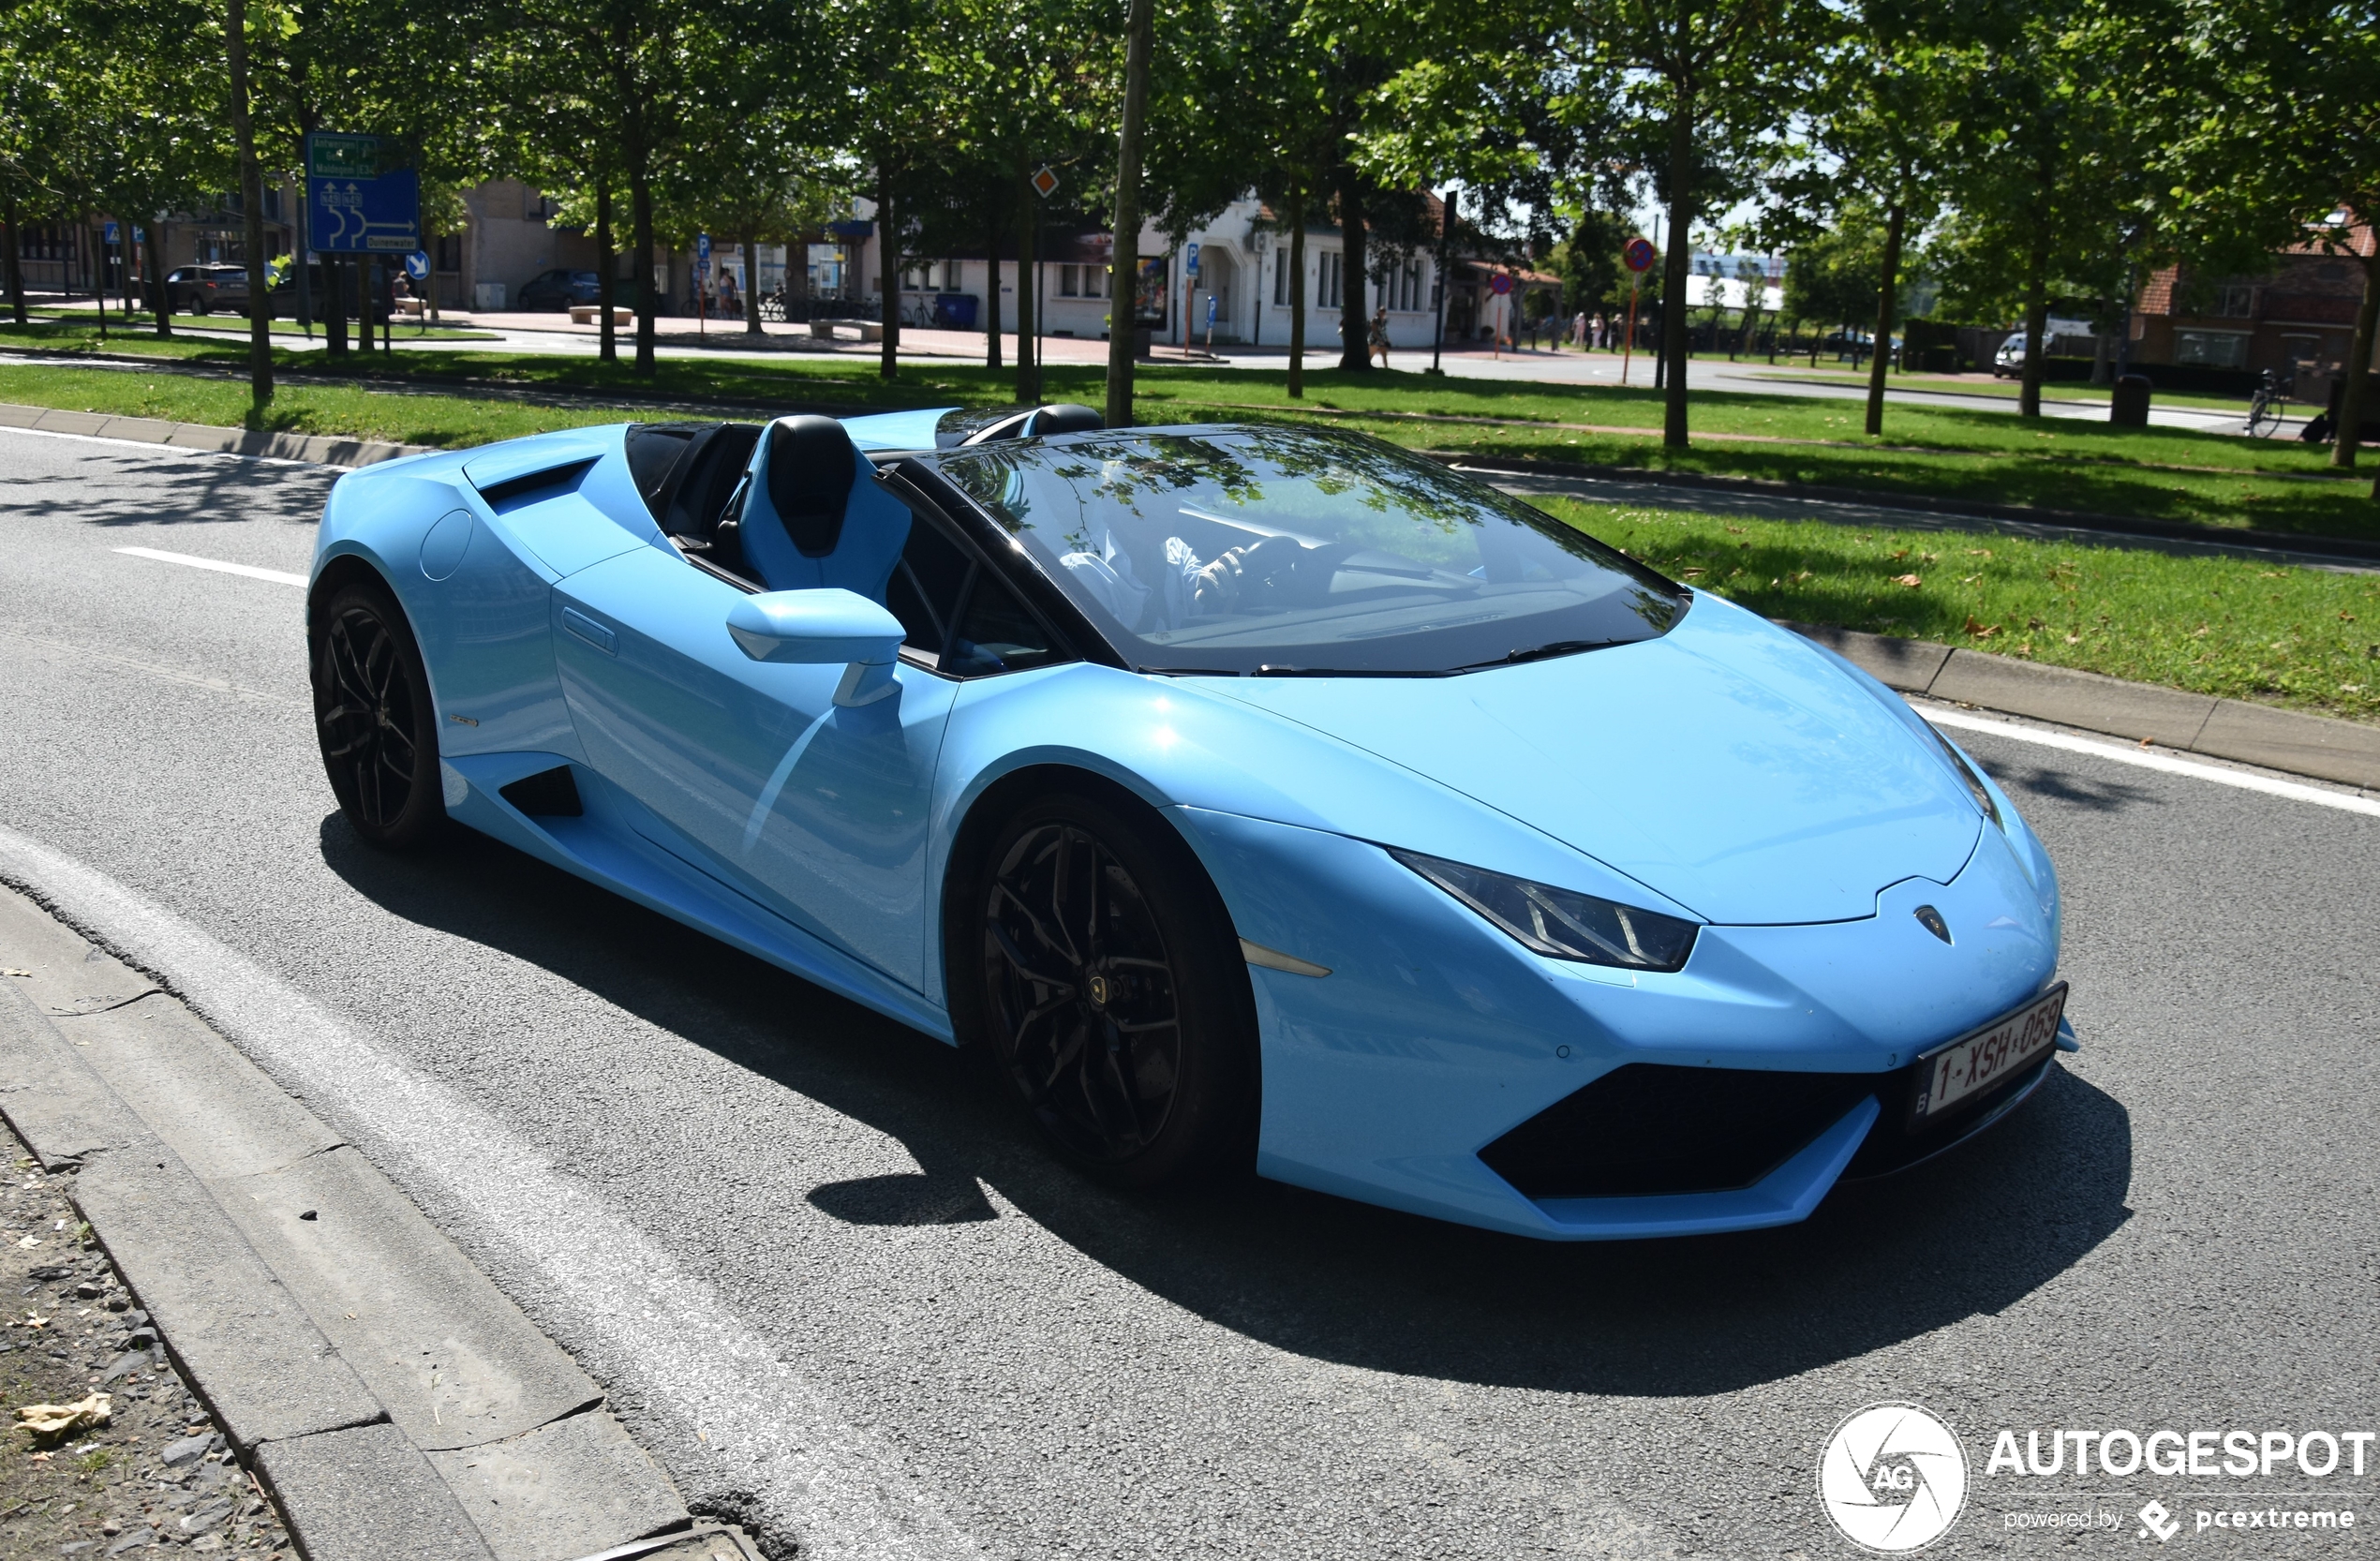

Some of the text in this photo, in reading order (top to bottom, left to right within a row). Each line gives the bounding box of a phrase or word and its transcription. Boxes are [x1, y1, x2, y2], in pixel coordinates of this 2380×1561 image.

[314, 138, 355, 149] Antwerpen
[316, 164, 355, 176] Maldegem
[322, 194, 360, 205] N49 N49
[368, 237, 414, 248] Duinenwater
[699, 238, 708, 255] P
[1189, 246, 1197, 264] P
[1209, 301, 1216, 318] P
[1940, 998, 2060, 1101] 1-XSH-059
[1915, 1093, 1927, 1114] B
